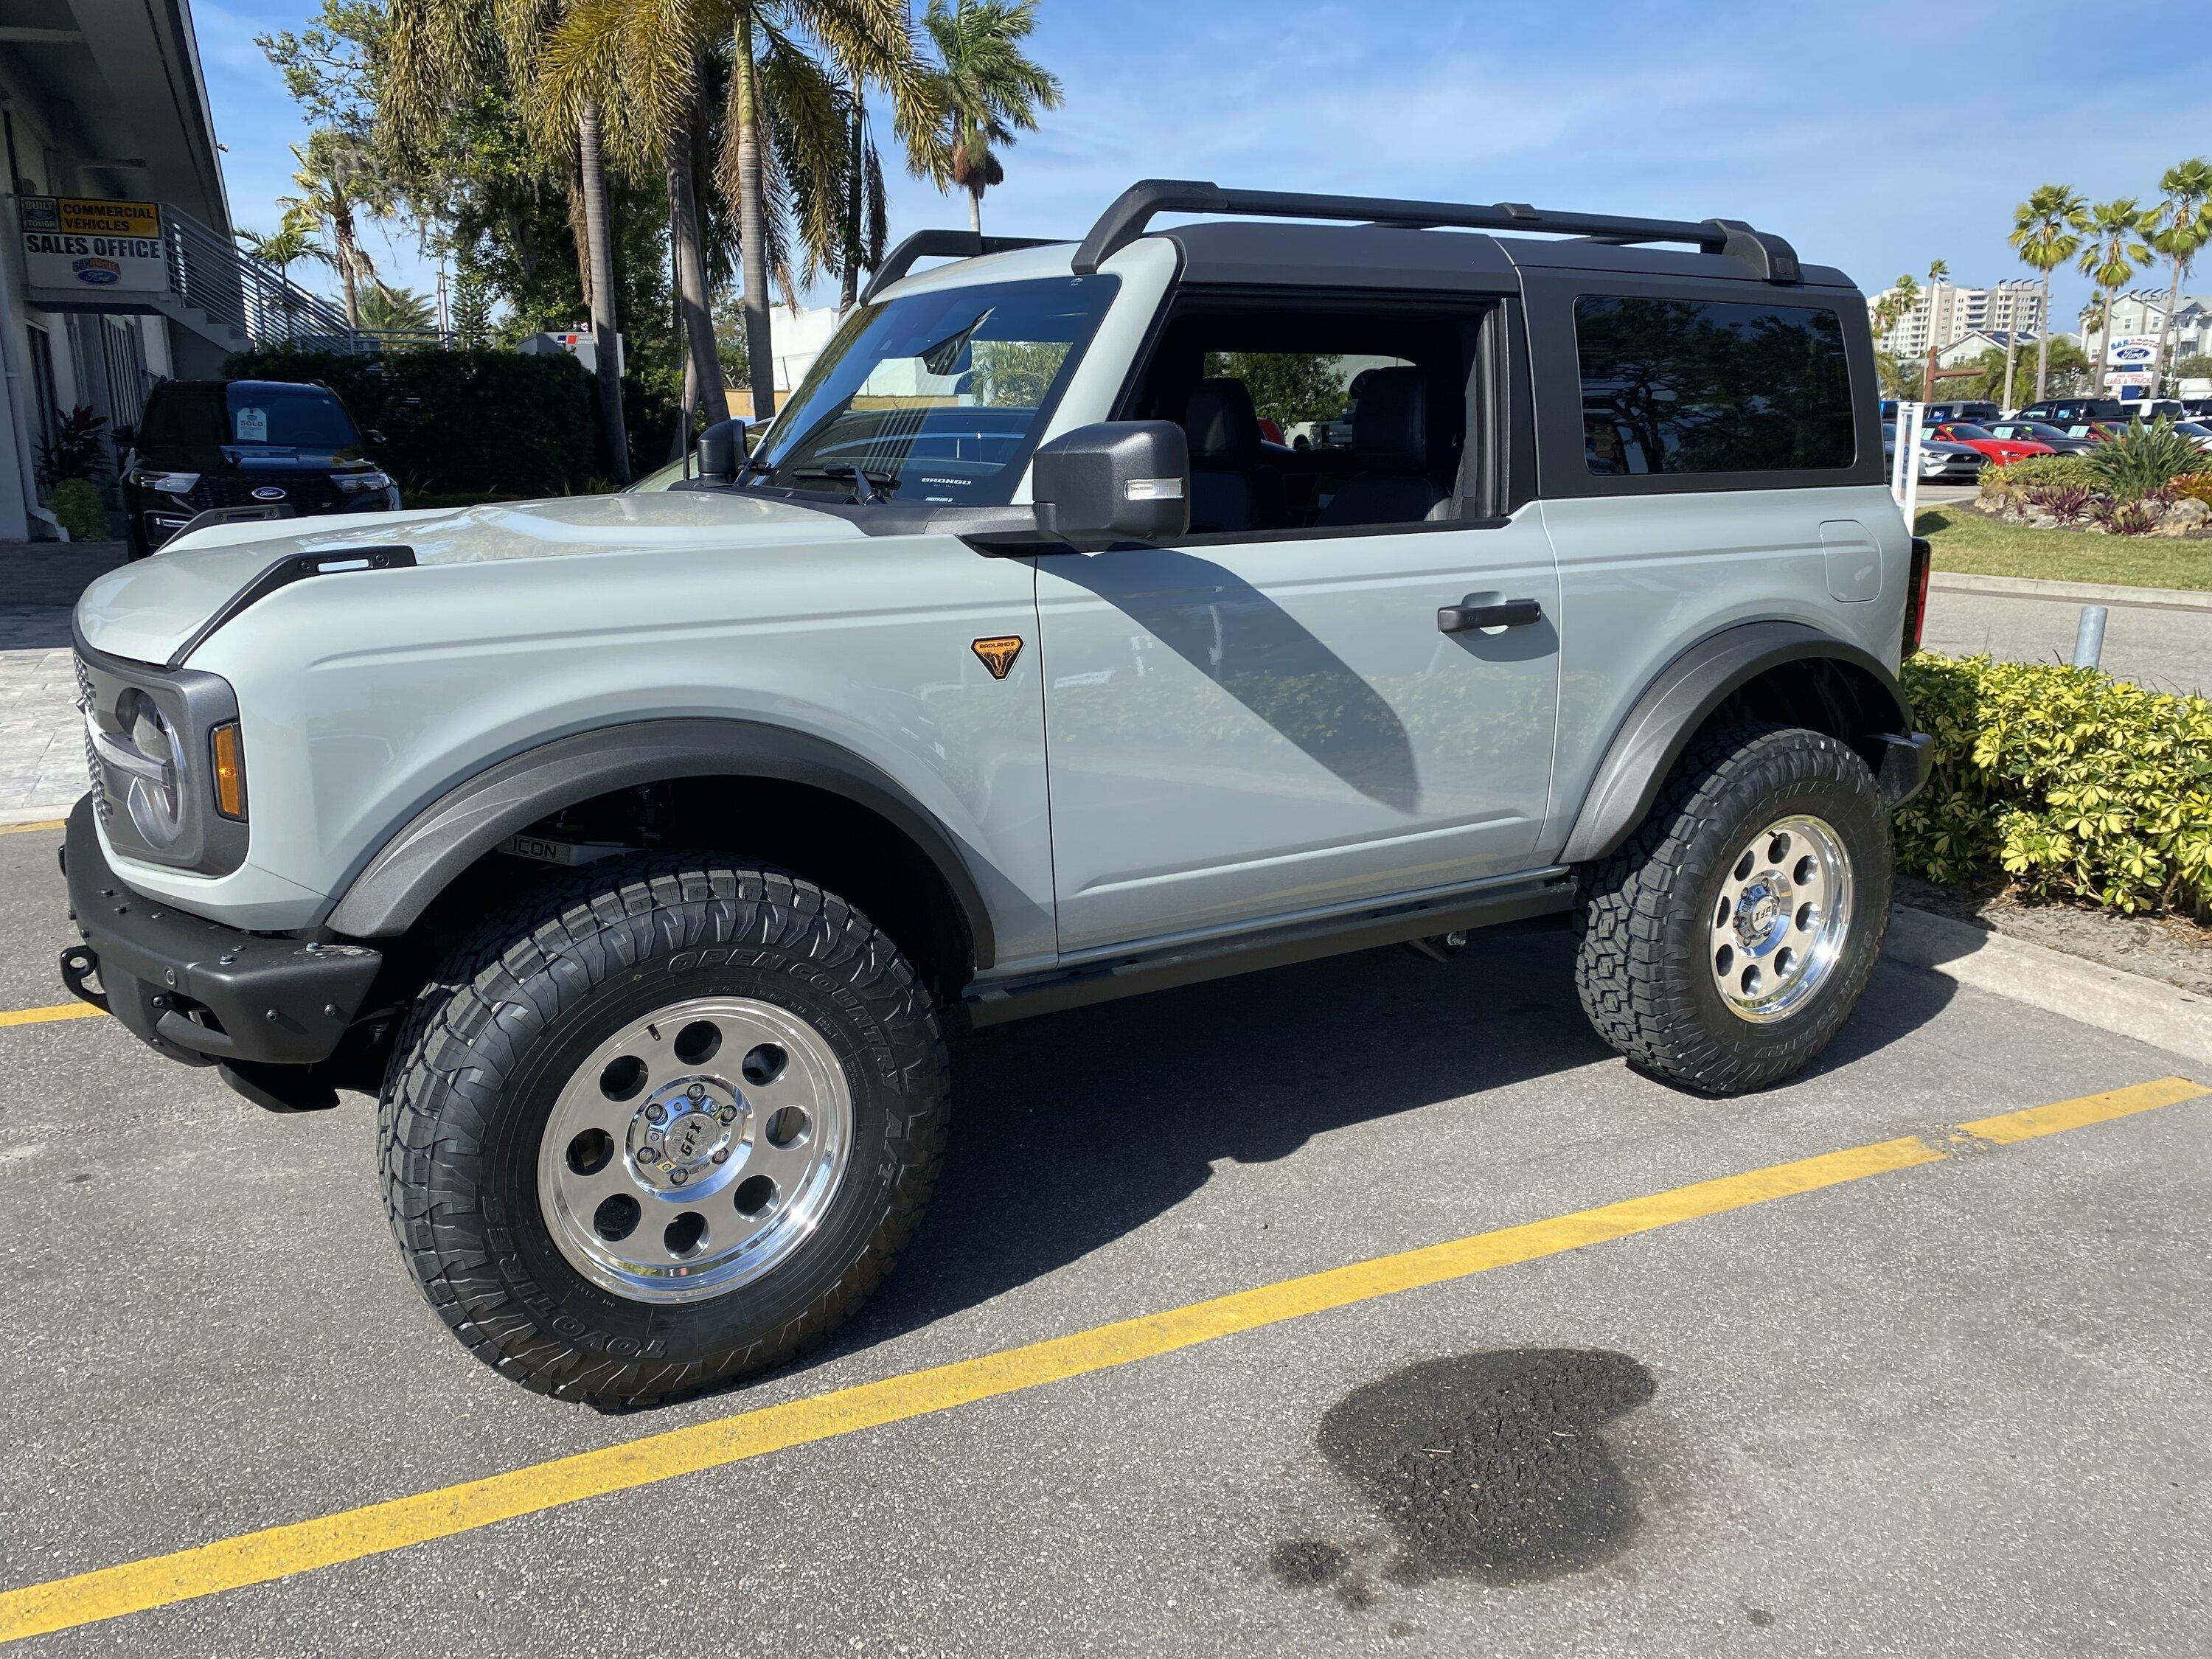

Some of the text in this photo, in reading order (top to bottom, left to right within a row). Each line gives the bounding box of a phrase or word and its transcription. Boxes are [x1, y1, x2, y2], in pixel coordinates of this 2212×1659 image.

[25, 201, 52, 210] BUILT
[62, 204, 153, 219] COMMERCIAL
[64, 218, 130, 232] VEHICLES
[27, 234, 160, 259] SALES OFFICE
[2121, 348, 2146, 359] Ford
[921, 477, 972, 485] BRONCO
[260, 489, 279, 497] Ford
[979, 641, 1015, 649] BADLANDS
[513, 838, 557, 860] ICON
[668, 948, 789, 973] OPEN
[789, 961, 905, 1096] COUNTRY
[680, 1120, 703, 1157] GFX
[481, 1195, 668, 1360] TOYO TIRES
